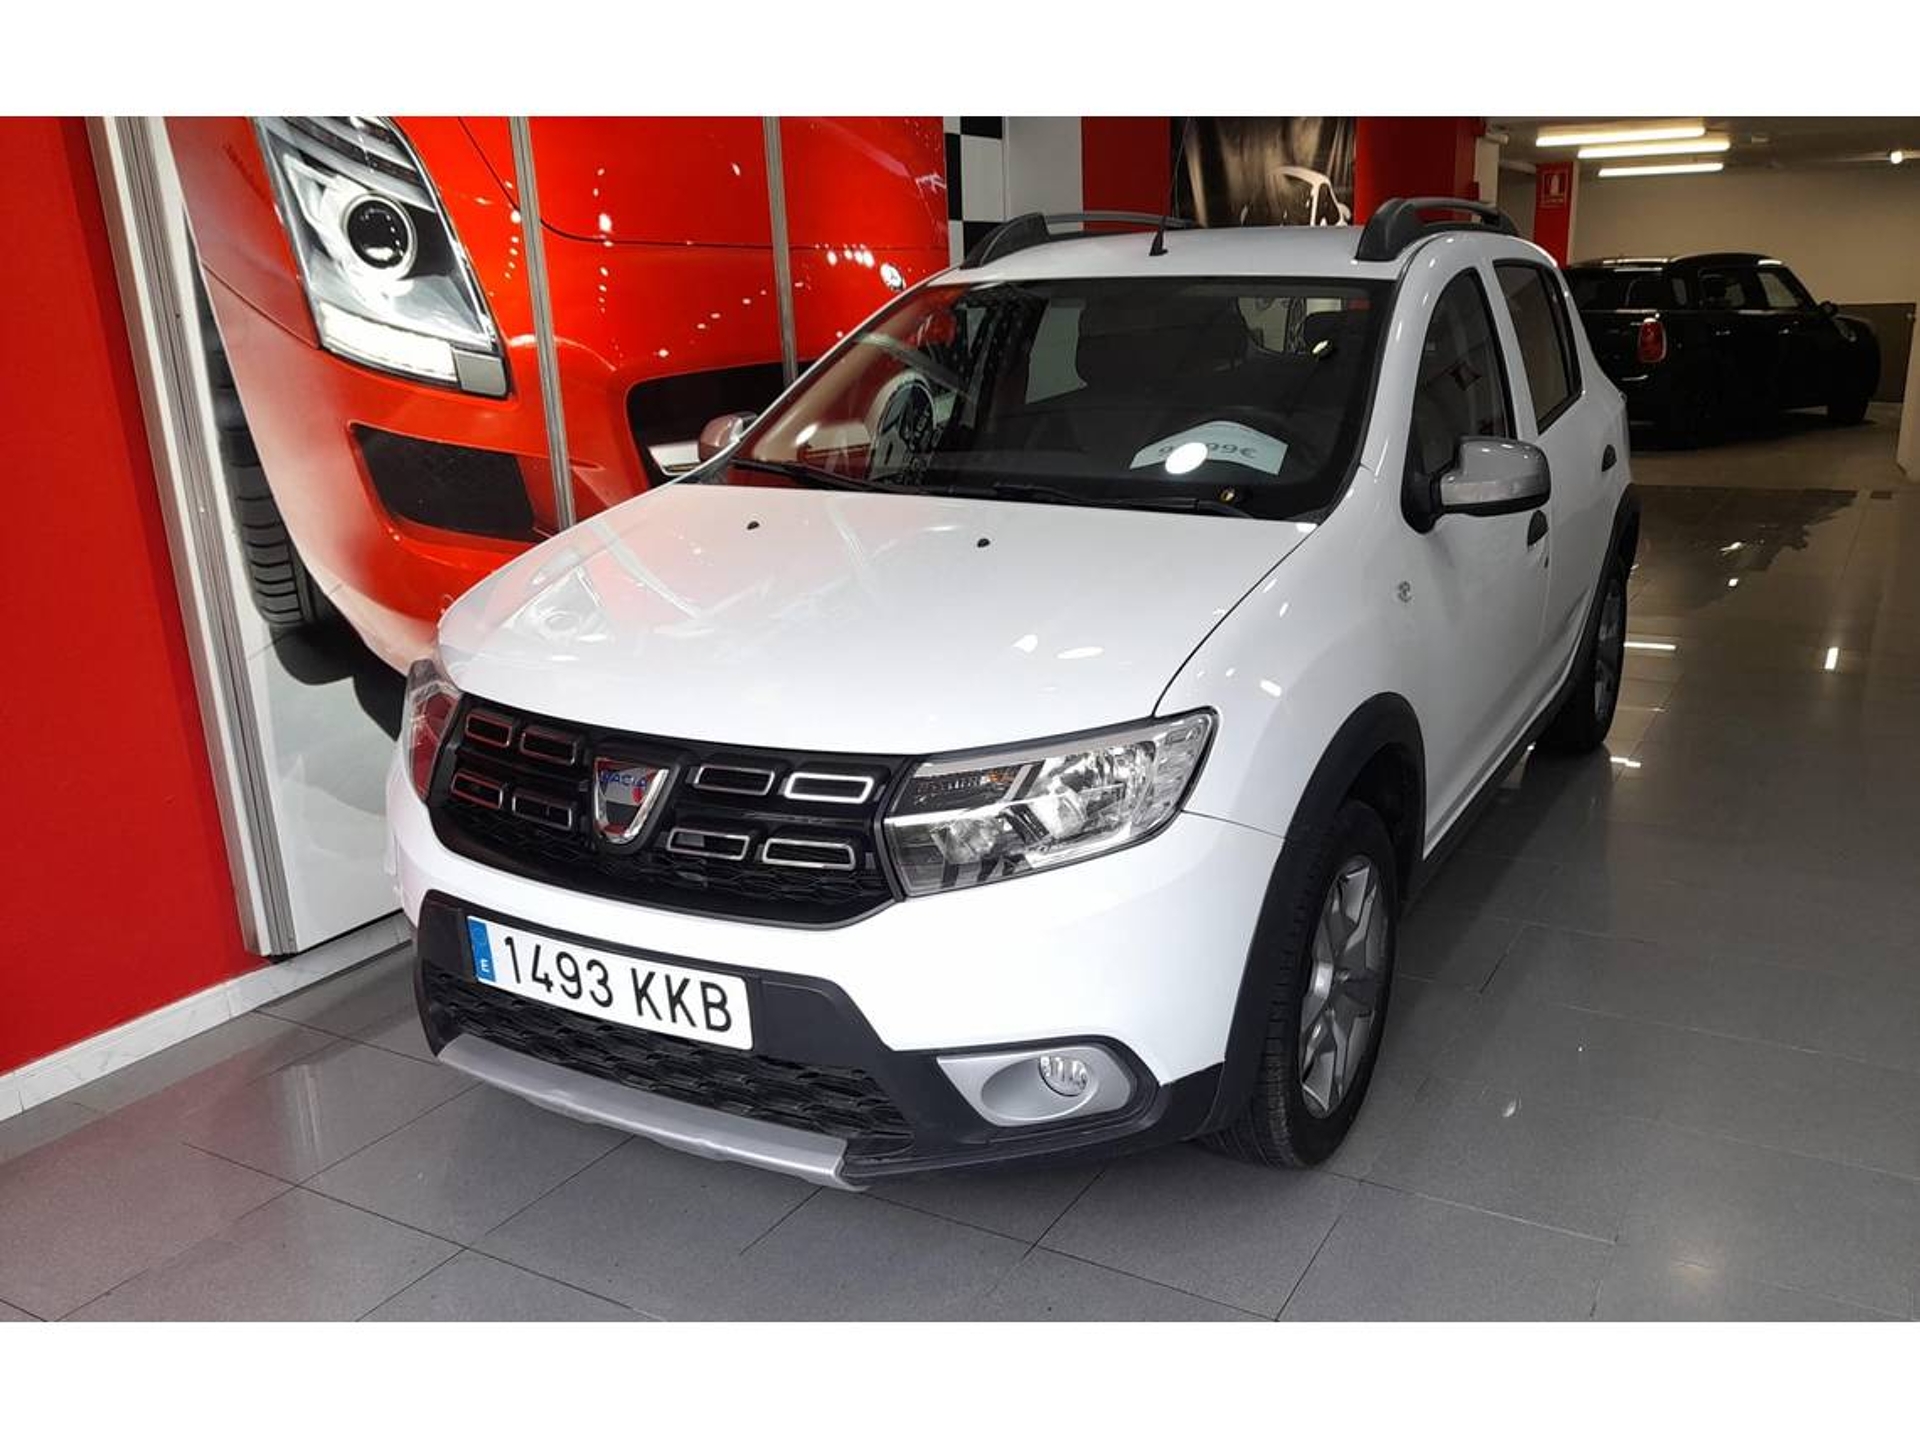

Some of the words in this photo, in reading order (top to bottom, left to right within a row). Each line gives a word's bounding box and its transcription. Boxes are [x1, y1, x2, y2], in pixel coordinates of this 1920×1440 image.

[480, 959, 490, 973] E
[504, 936, 614, 1008] 1493
[630, 967, 732, 1033] KKB
